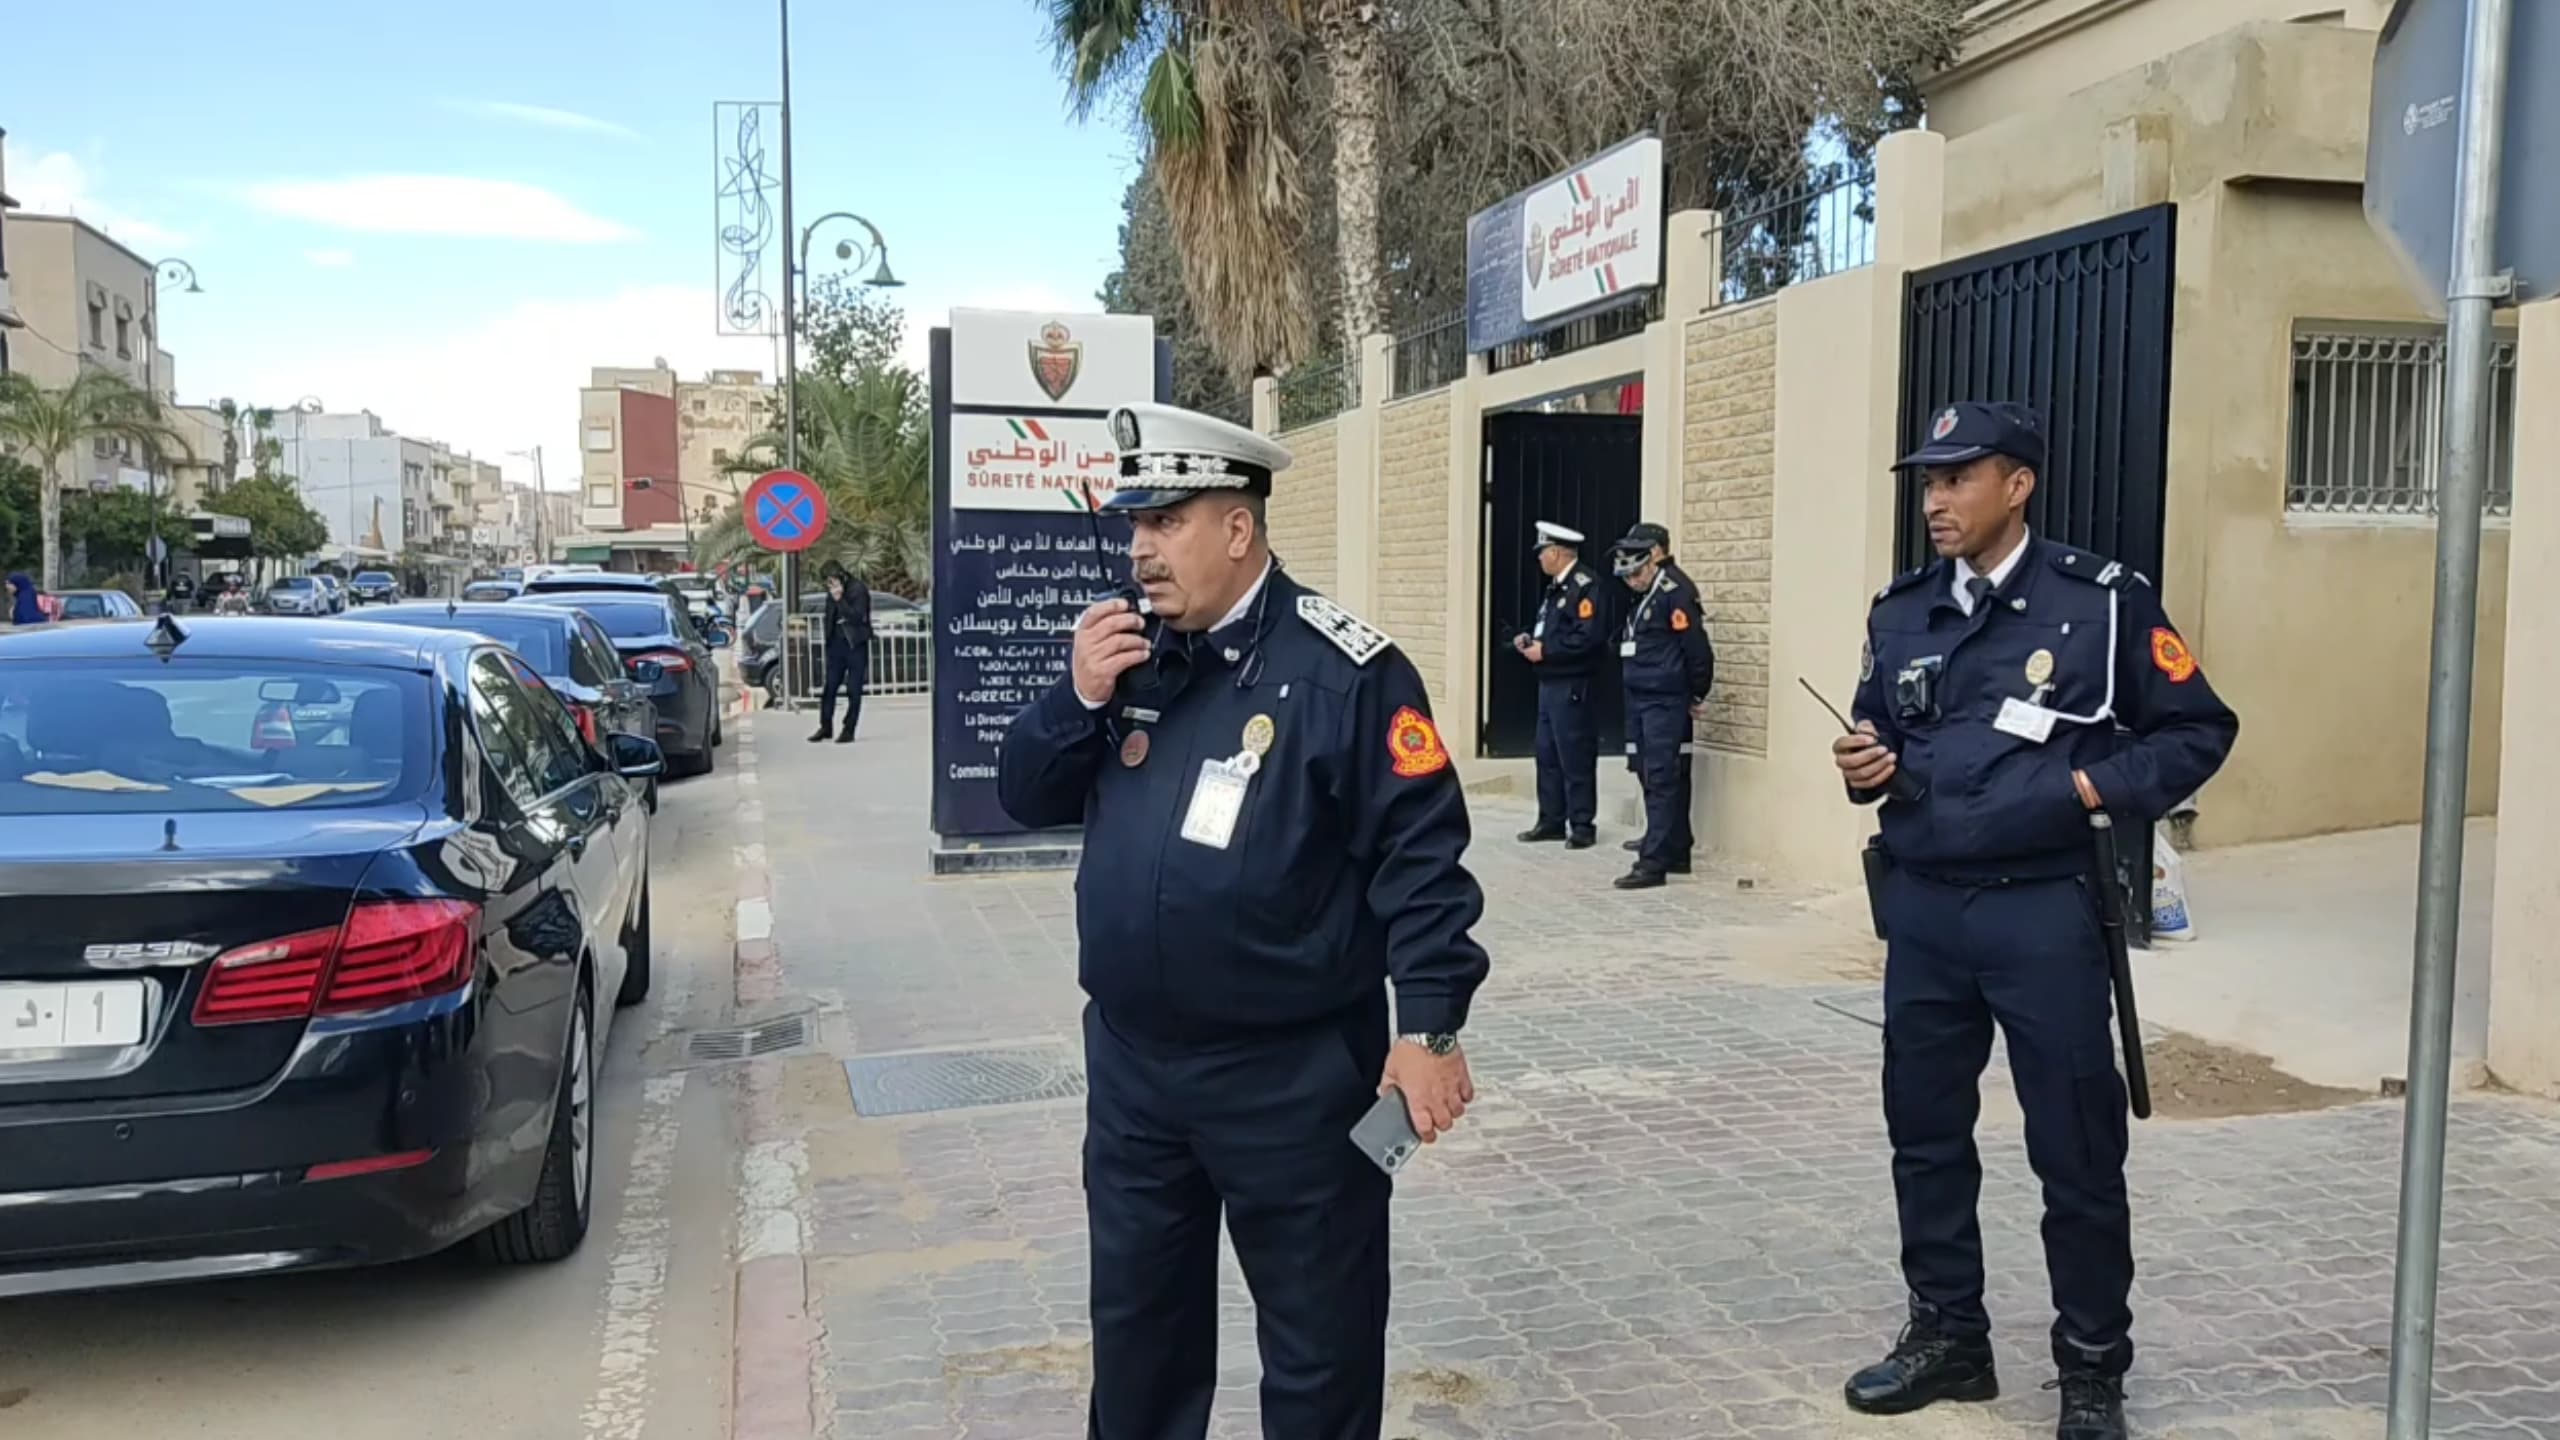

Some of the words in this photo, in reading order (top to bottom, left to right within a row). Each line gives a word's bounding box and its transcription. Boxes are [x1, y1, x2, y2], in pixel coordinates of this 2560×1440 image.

[1604, 176, 1640, 229] الأمن
[1548, 195, 1601, 256] الوطني
[1548, 247, 1584, 280] SÛRETÉ
[1586, 228, 1638, 266] NATIONALE
[967, 439, 1067, 469] الوطني
[967, 471, 1035, 488] SÛRETÉ
[1041, 474, 1115, 489] NATIONA
[950, 534, 1005, 555] الوطني
[1010, 532, 1050, 553] للأمن
[1055, 536, 1096, 551] العامة
[995, 562, 1049, 580] مكناس
[1051, 560, 1078, 580] أمن
[976, 584, 1012, 608] للأمن
[1015, 585, 1059, 610] الأولى
[949, 612, 1017, 636] بويسلان
[964, 712, 977, 727] La
[978, 729, 1004, 742] Préfe
[949, 763, 999, 779] Commiss
